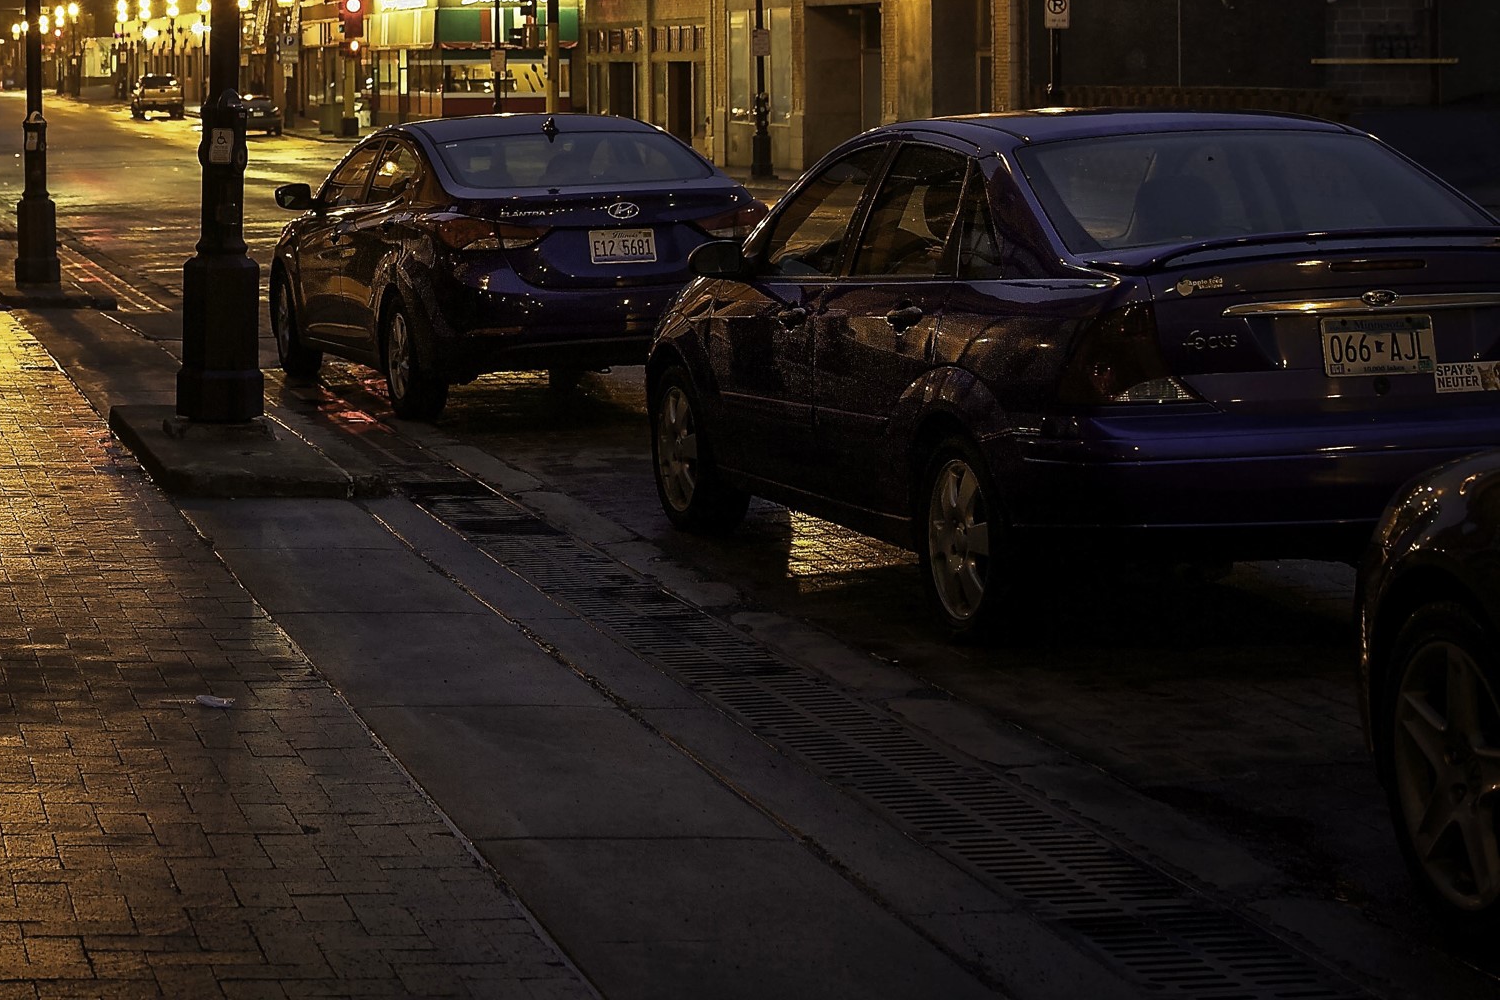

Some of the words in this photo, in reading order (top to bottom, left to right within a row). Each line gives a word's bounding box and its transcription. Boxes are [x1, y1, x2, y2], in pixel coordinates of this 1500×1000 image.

[500, 210, 546, 218] ELANTRA
[593, 240, 617, 257] E12
[622, 238, 654, 256] 5681
[1354, 320, 1405, 331] Minnesota
[1330, 334, 1371, 364] 066
[1390, 331, 1431, 362] AJL
[1436, 364, 1465, 377] SPAY
[1437, 375, 1480, 389] NEUTER
